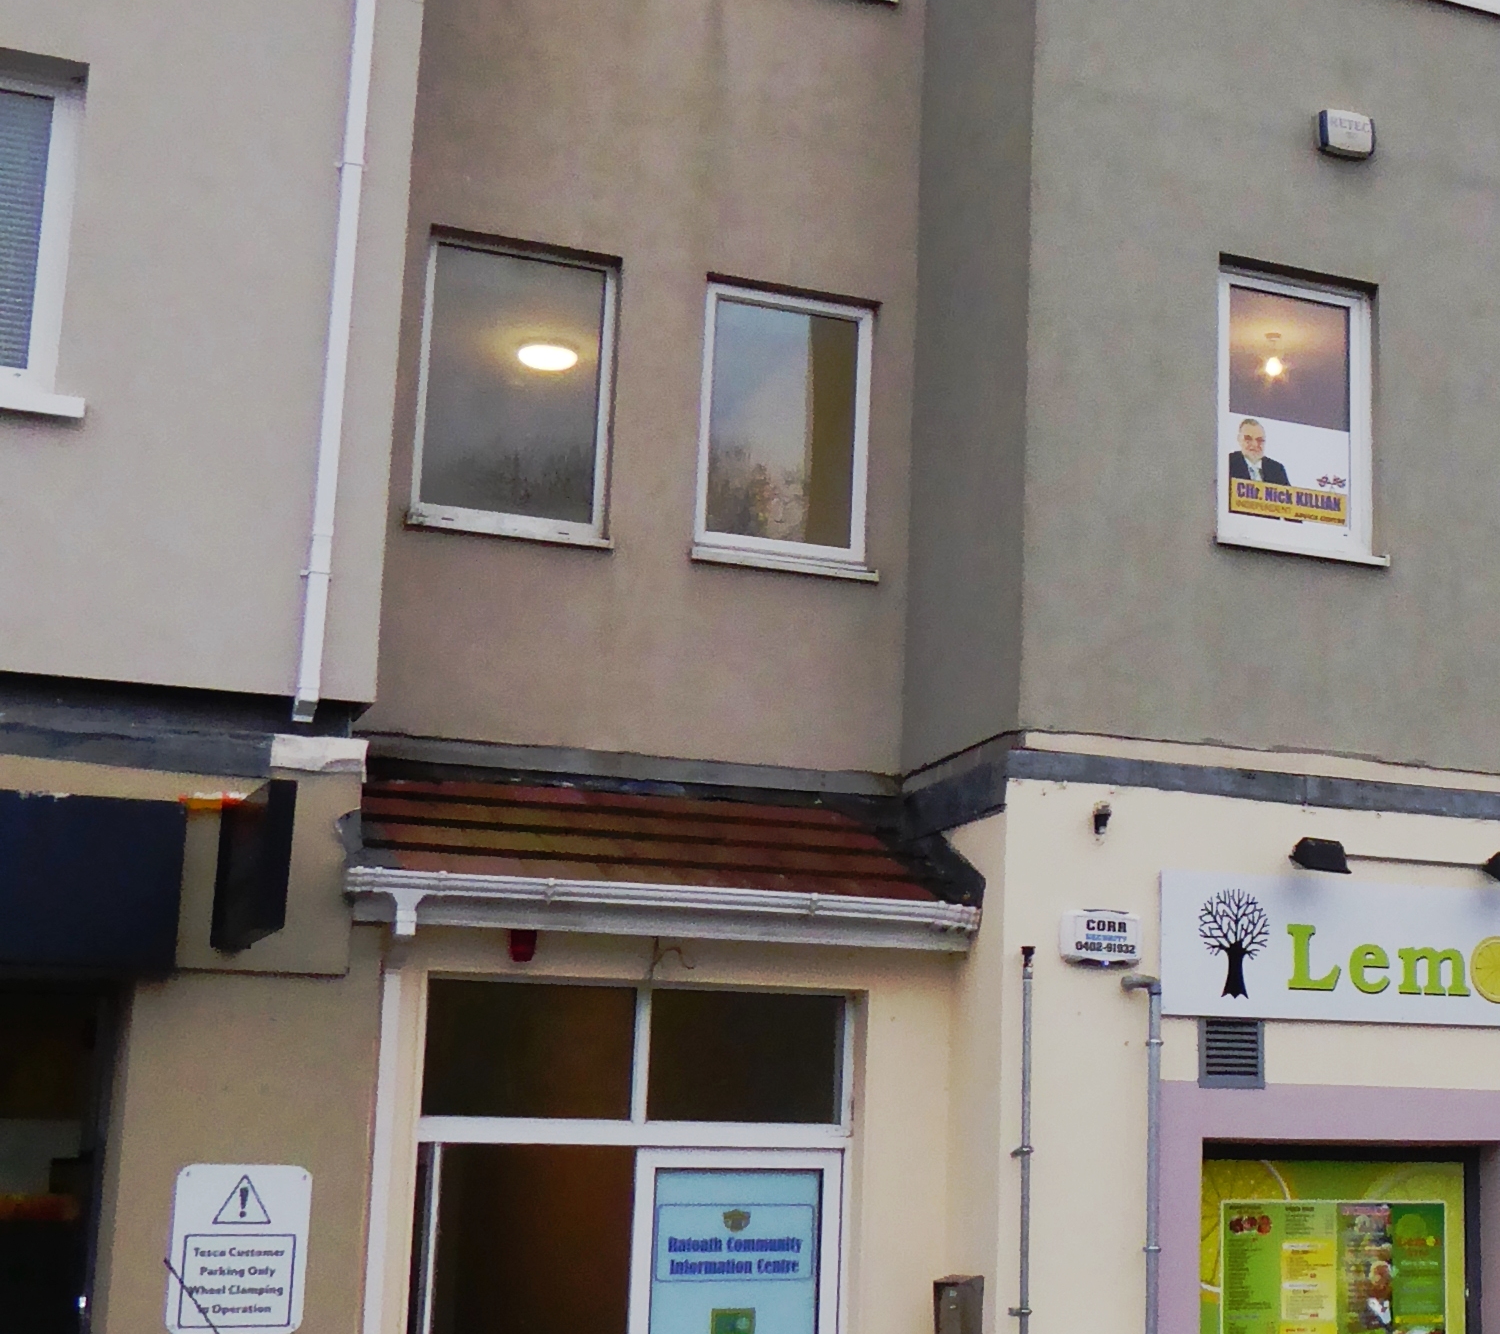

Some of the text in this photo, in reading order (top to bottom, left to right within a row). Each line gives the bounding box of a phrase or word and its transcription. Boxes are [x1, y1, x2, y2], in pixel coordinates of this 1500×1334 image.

[1264, 486, 1293, 506] Nick
[1295, 491, 1342, 513] KILLIAN
[726, 1236, 803, 1254] Community
[229, 1247, 285, 1258] Customer
[200, 1266, 276, 1278] Parking Only
[669, 1258, 800, 1275] Information Centre
[228, 1284, 284, 1297] Clamping
[212, 1304, 272, 1315] Operation
